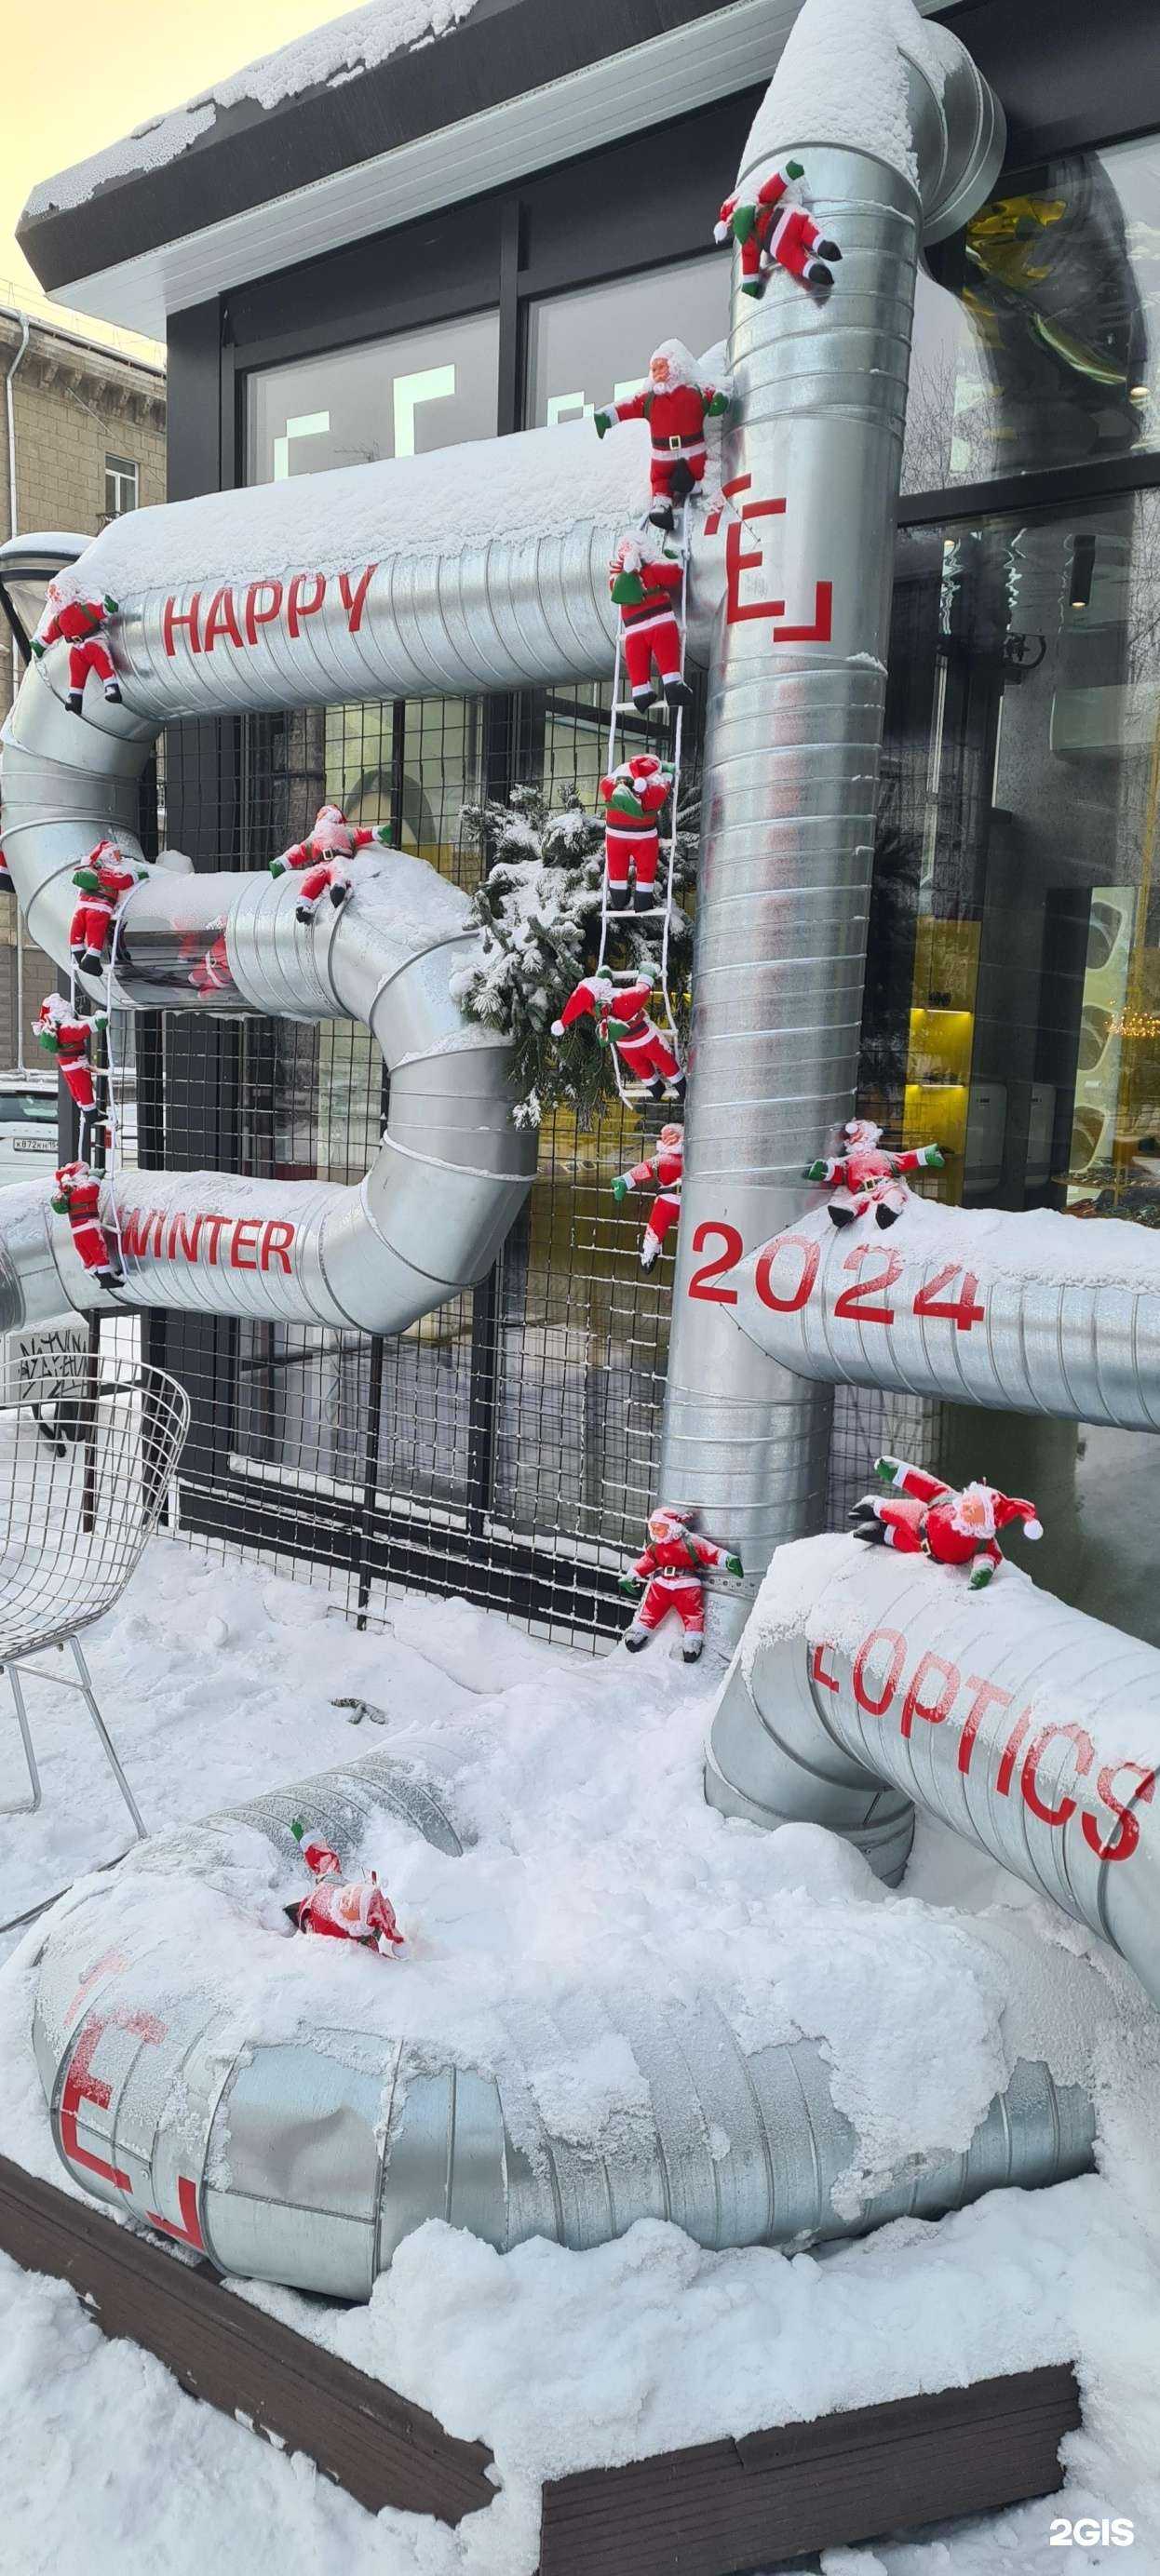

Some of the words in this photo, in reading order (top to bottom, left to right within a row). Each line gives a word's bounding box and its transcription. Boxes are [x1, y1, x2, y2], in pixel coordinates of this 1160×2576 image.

[163, 563, 378, 657] HAPPY
[116, 1205, 296, 1274] WINTER
[688, 1221, 985, 1331] 2024
